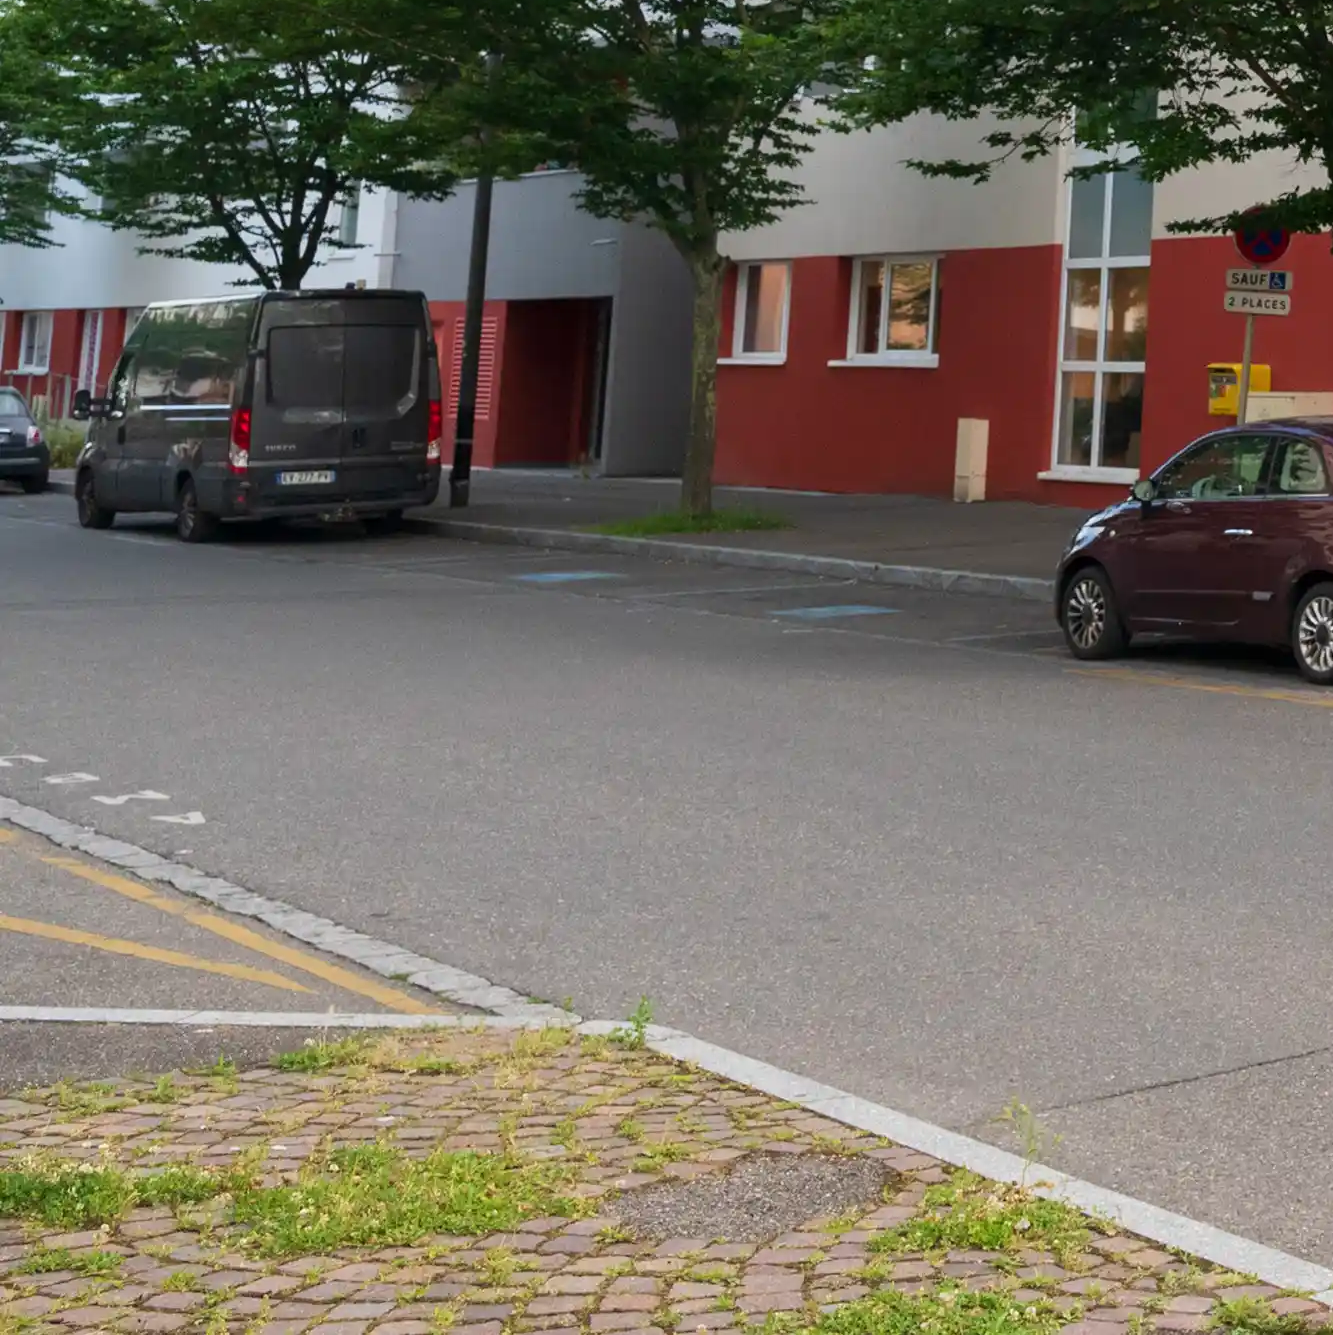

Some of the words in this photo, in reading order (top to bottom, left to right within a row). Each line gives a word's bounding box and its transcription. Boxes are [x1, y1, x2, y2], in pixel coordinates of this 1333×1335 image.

[1231, 272, 1268, 286] SAUF
[1228, 296, 1236, 307] 2
[1241, 297, 1287, 311] PLACES
